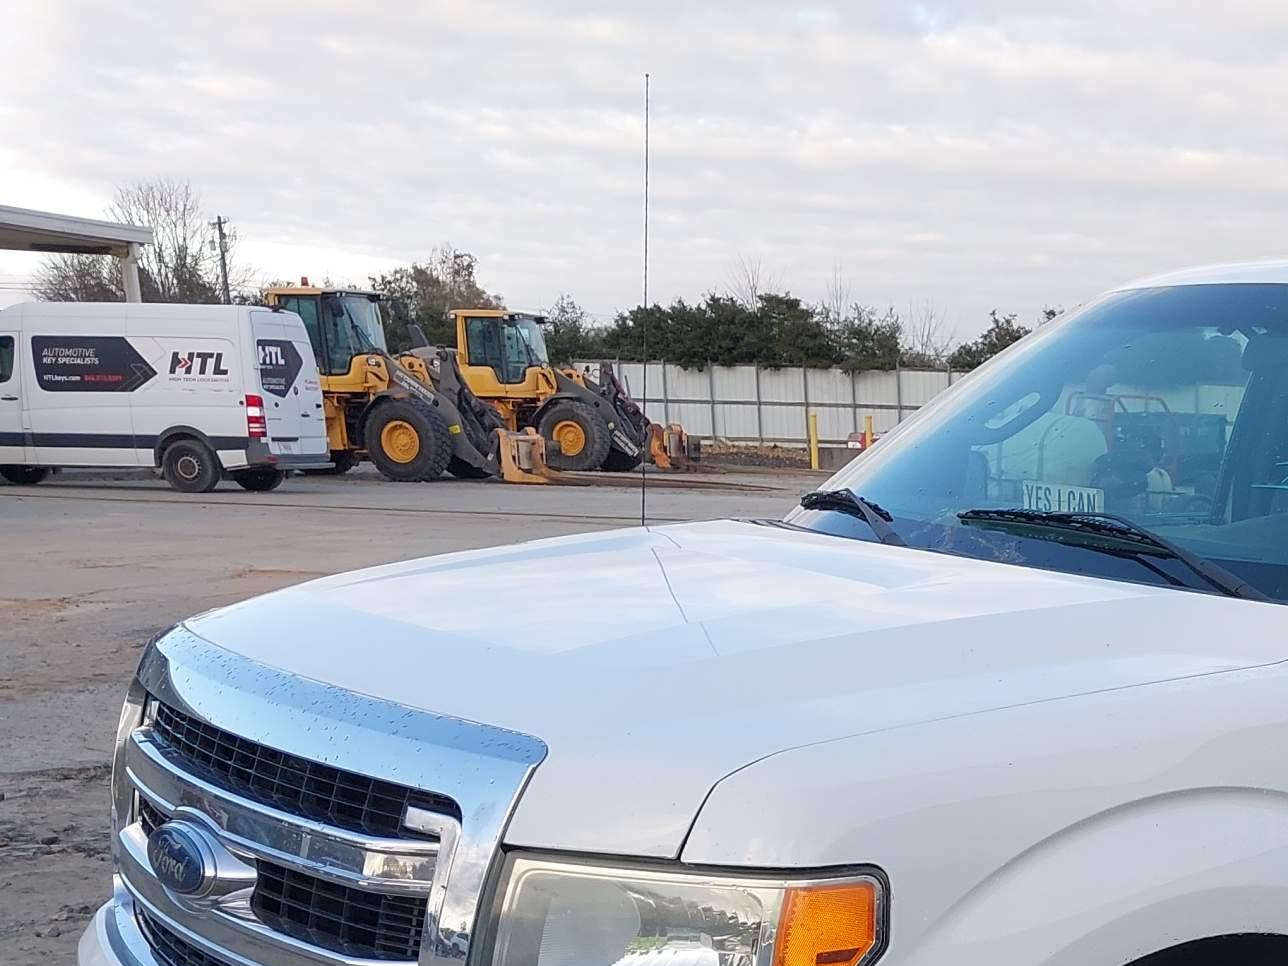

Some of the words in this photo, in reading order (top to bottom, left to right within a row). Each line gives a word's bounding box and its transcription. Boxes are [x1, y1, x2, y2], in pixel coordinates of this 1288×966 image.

[41, 347, 96, 357] AUTOMOTIVE
[42, 356, 56, 365] KEY
[57, 356, 99, 366] SPECIALISTS
[257, 345, 286, 365] HTL
[168, 351, 229, 376] HTL
[1025, 484, 1052, 512] YES
[1067, 490, 1096, 513] CAN
